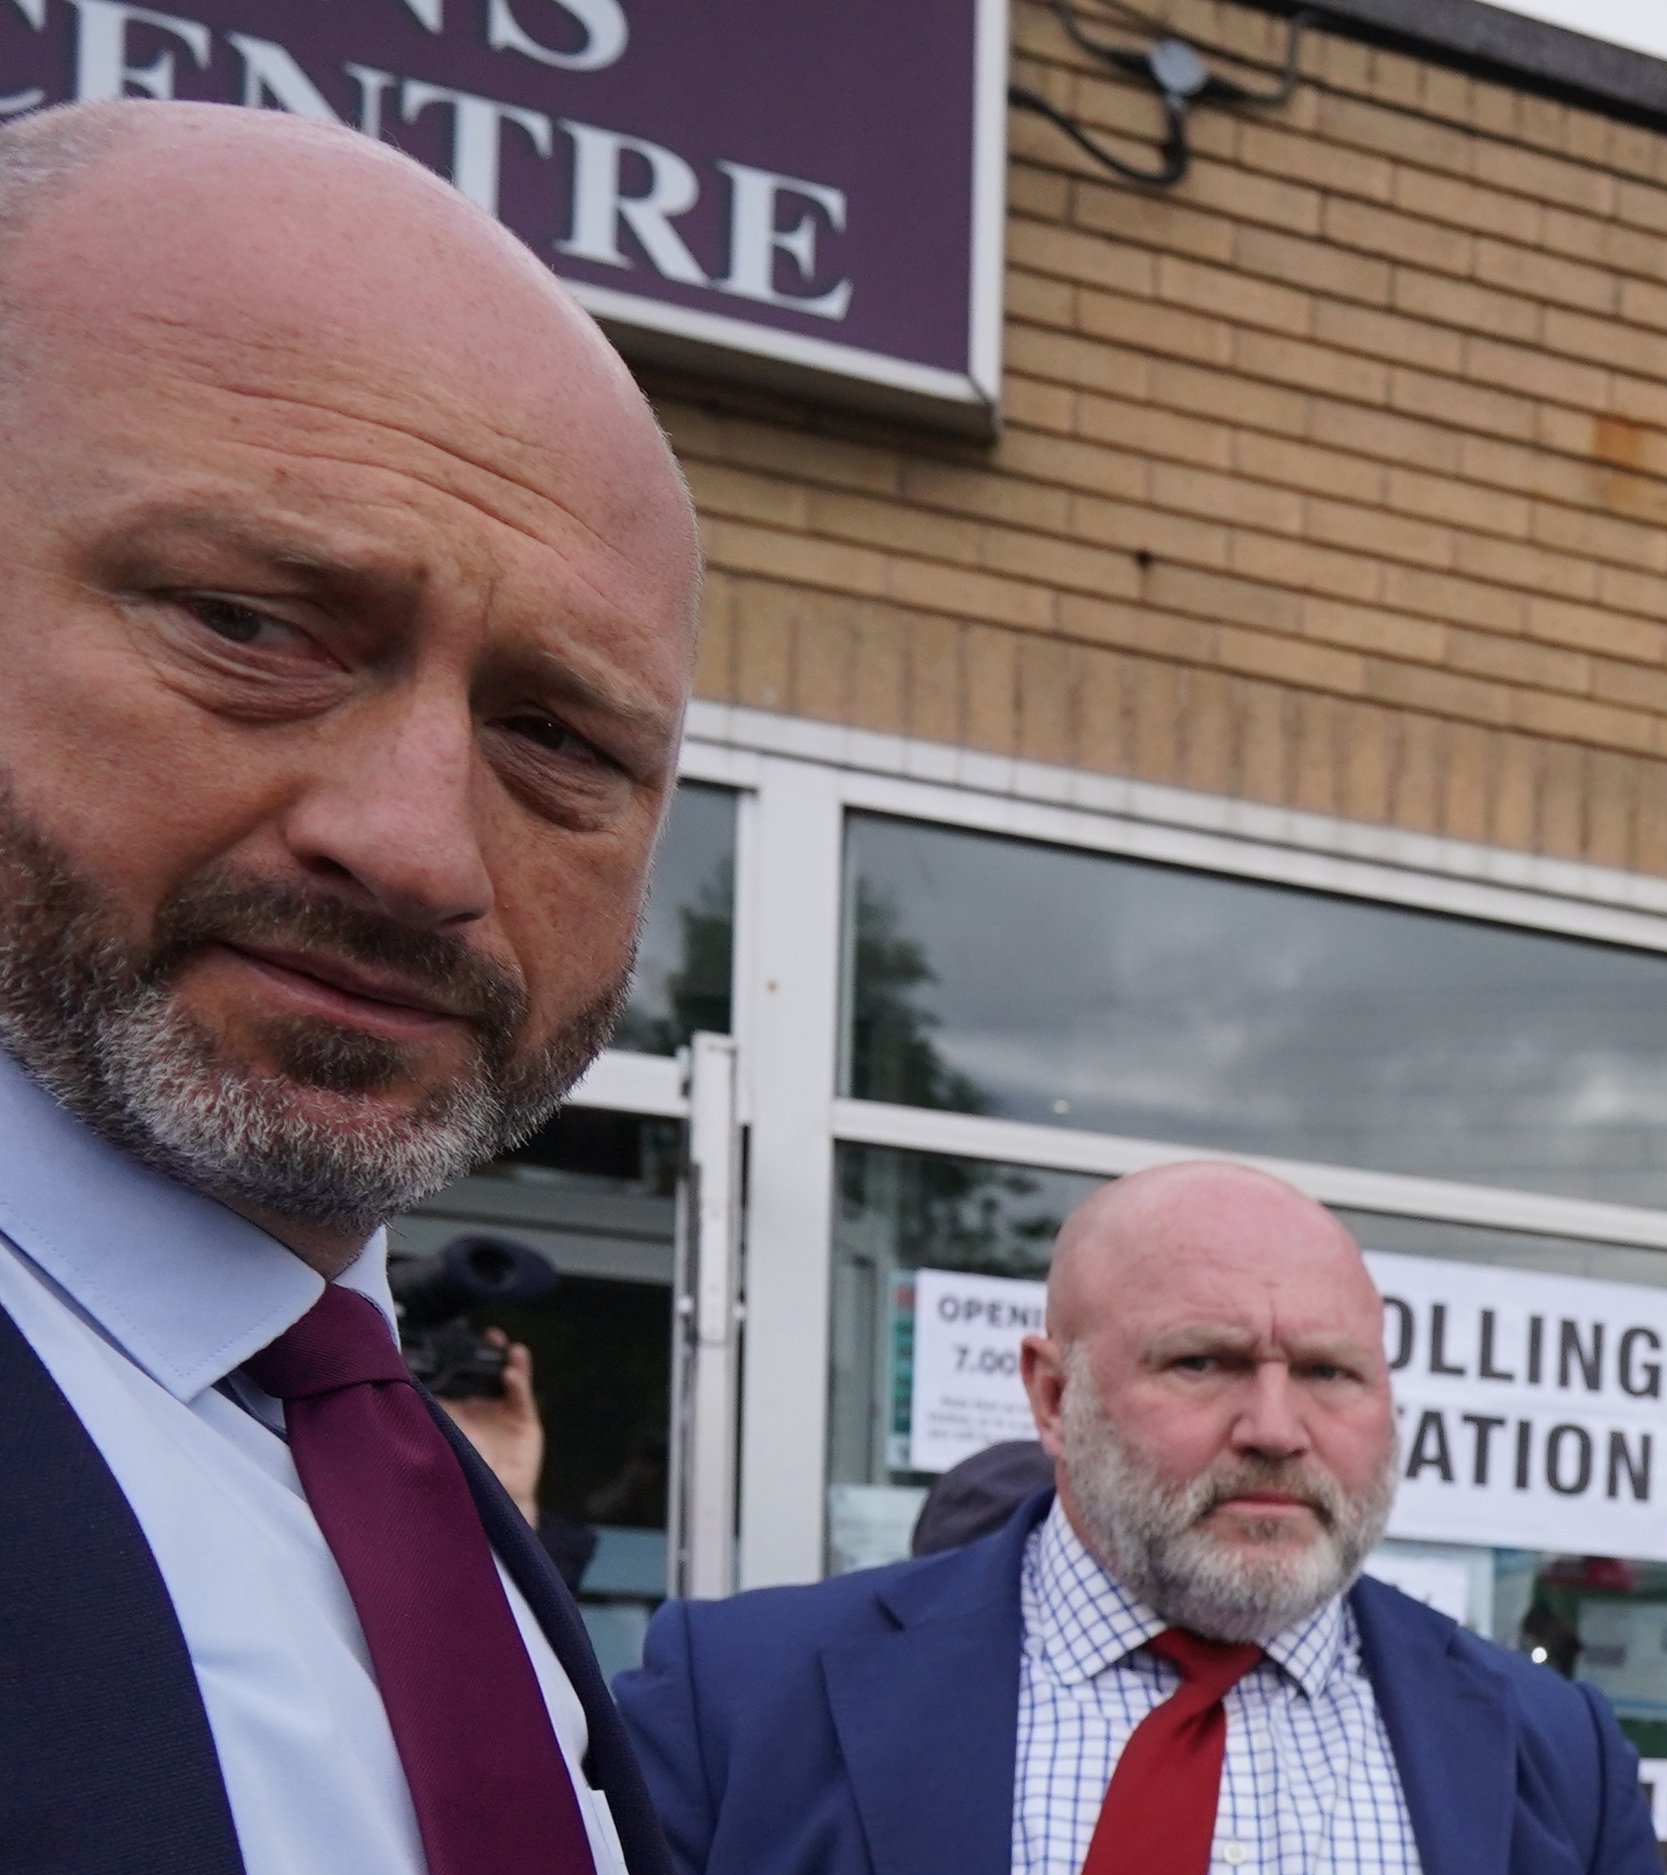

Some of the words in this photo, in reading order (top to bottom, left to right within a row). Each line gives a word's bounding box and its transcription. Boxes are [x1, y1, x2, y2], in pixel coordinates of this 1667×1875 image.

[938, 1296, 1041, 1327] OPENI
[1383, 1296, 1662, 1398] OLLING
[1398, 1407, 1652, 1503] ATION
